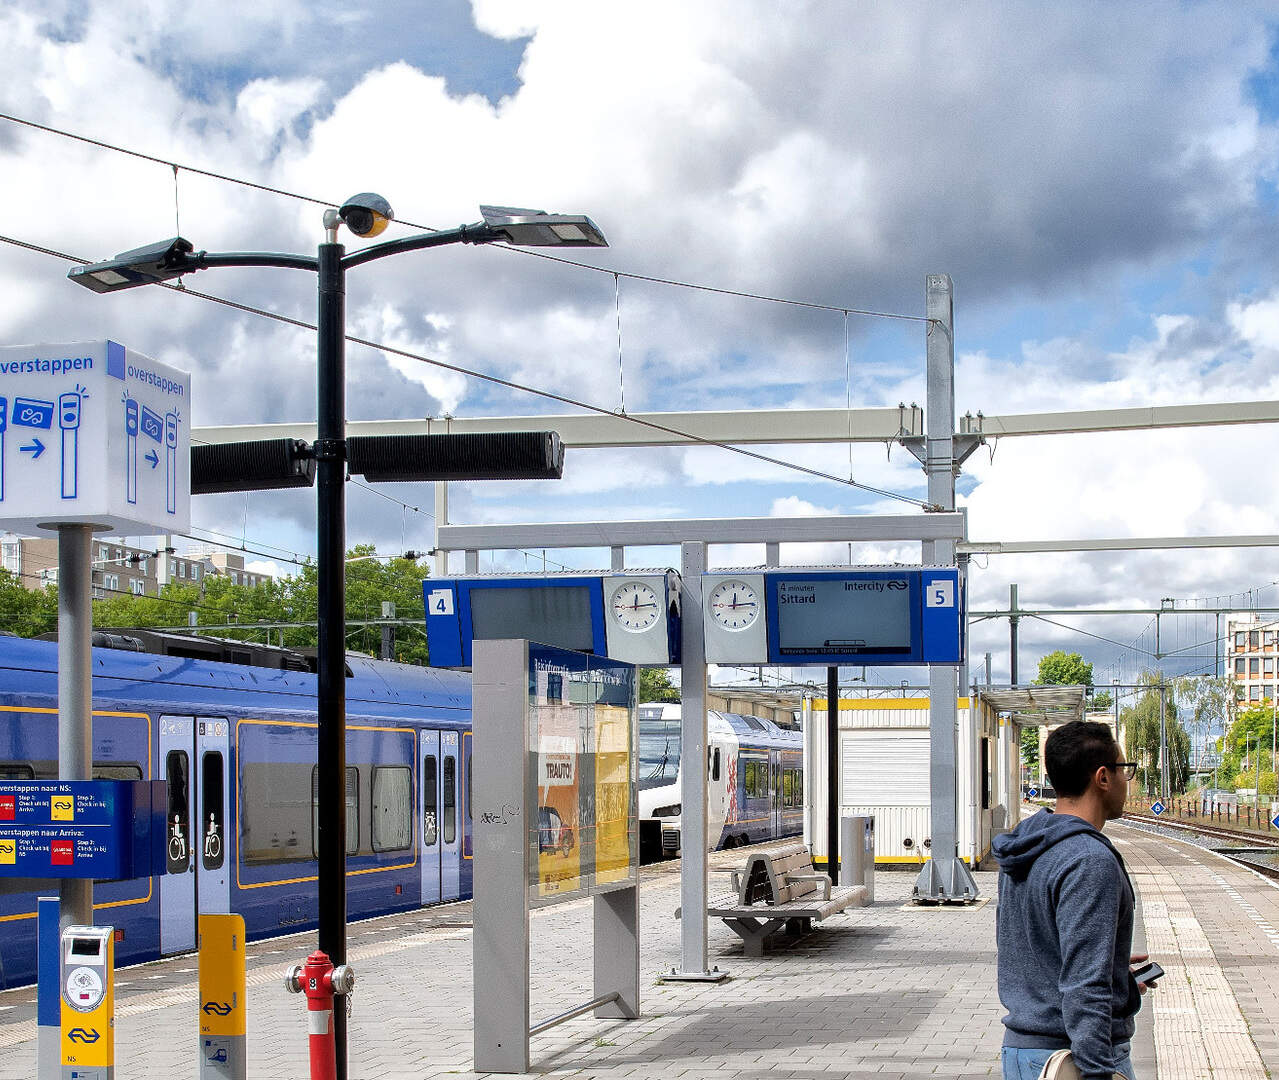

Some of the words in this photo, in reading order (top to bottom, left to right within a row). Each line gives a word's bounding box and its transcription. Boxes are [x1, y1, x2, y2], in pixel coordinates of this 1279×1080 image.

[127, 364, 184, 396] overstappen
[780, 582, 786, 591] 4
[844, 582, 884, 592] Intercity
[780, 594, 816, 604] Sittard
[935, 590, 945, 605] 5
[436, 598, 447, 612] 4
[59, 784, 72, 792] NS:
[59, 829, 84, 837] Arriva:
